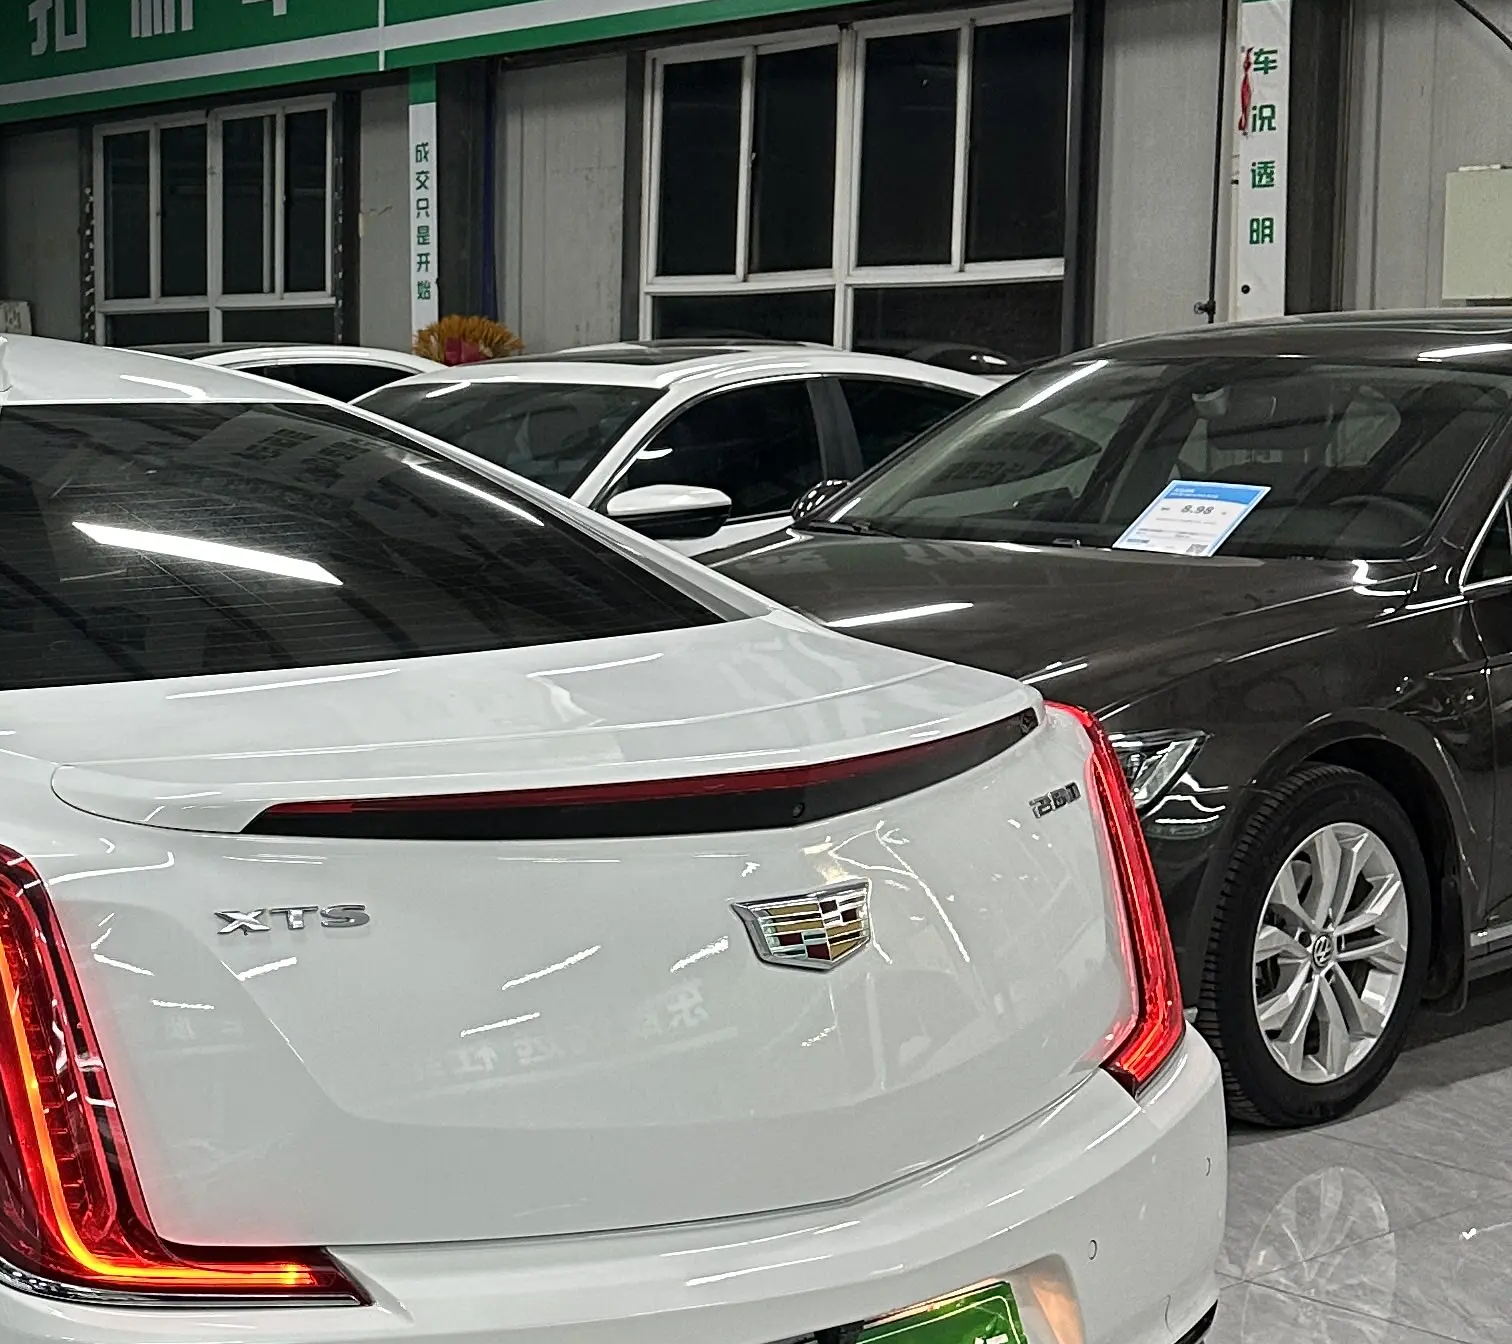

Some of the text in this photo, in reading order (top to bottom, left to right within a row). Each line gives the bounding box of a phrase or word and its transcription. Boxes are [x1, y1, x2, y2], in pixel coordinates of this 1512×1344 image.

[1249, 47, 1278, 245] 车况透明
[415, 142, 431, 301] 成交只是开始
[1180, 504, 1215, 515] 8.98
[213, 904, 371, 935] XTS
